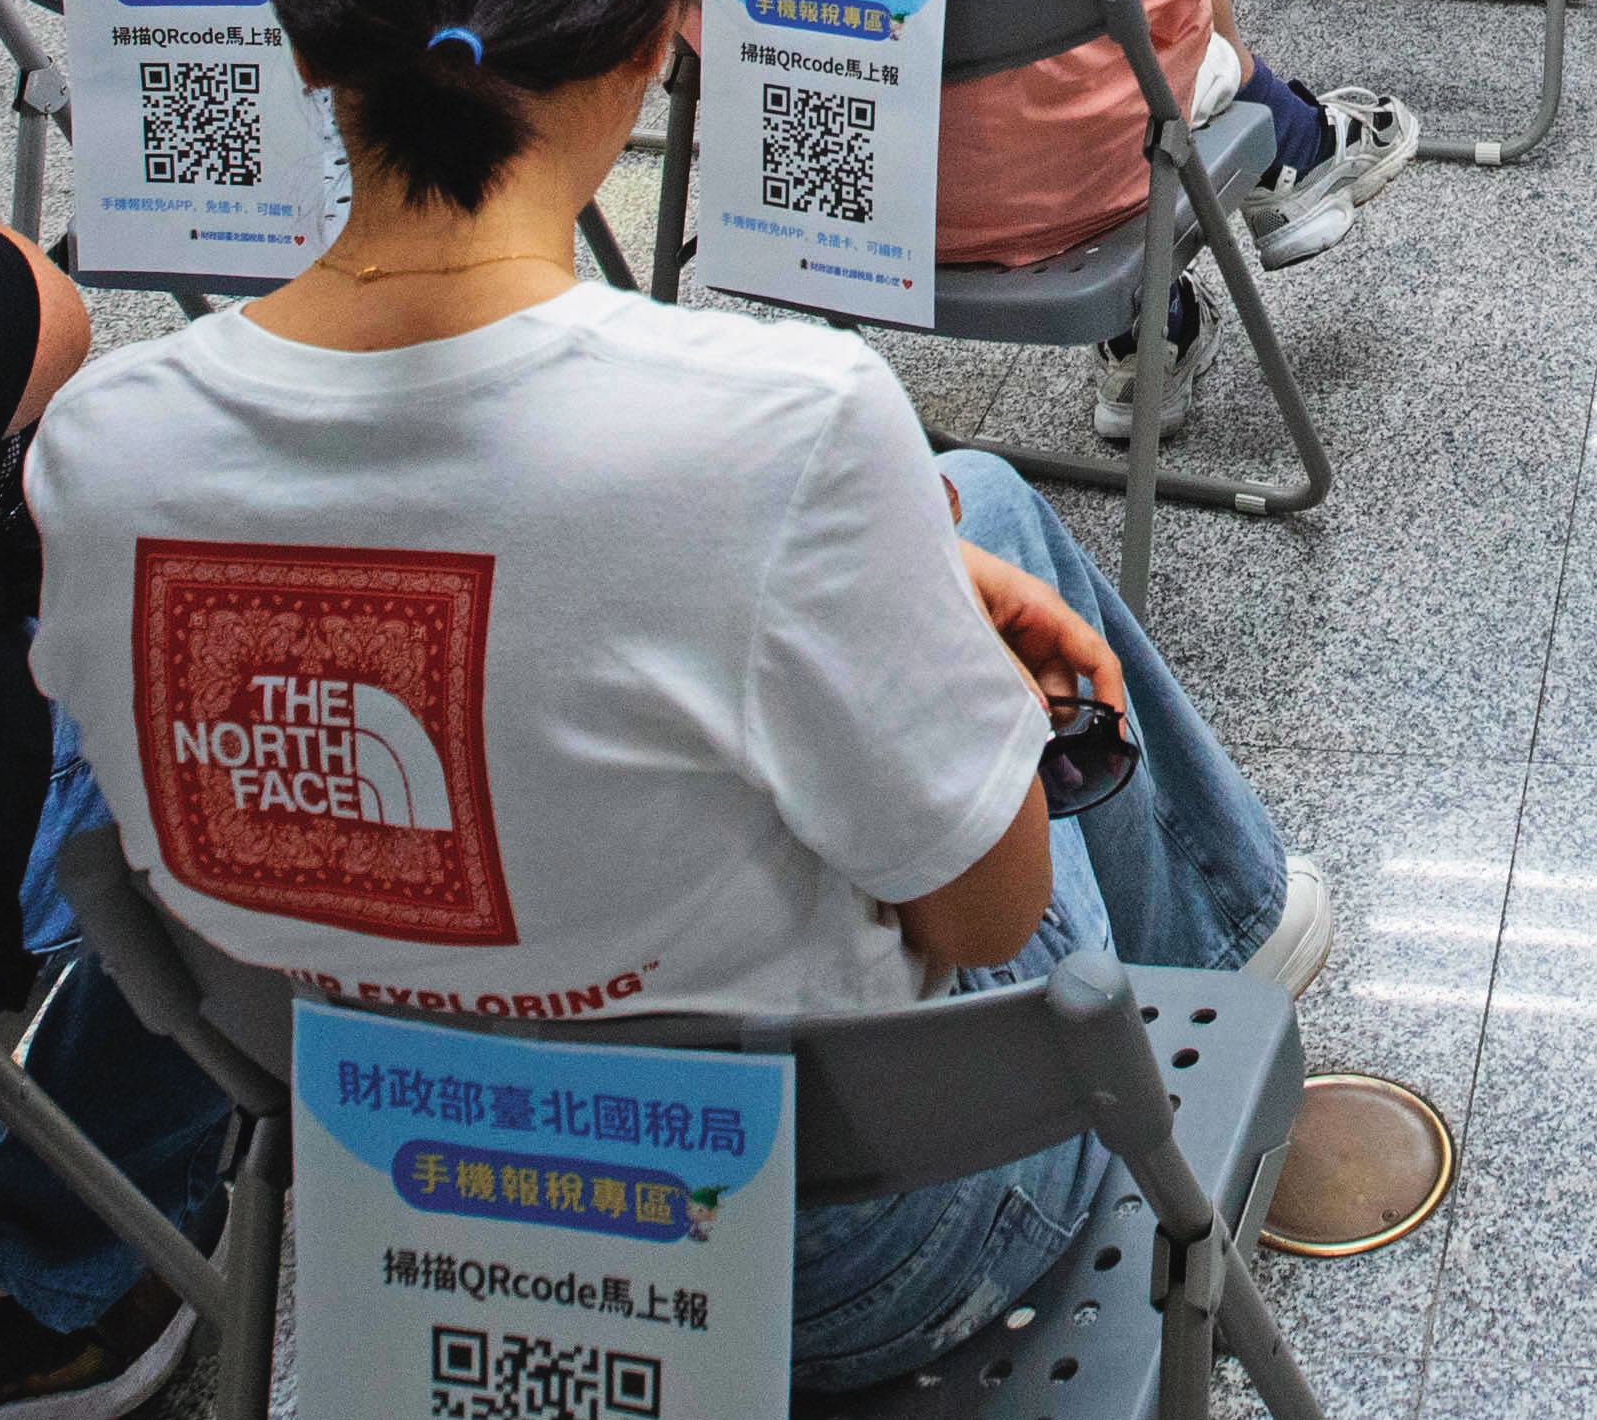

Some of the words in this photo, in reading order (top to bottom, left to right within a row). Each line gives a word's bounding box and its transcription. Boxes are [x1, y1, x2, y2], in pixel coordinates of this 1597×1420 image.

[112, 25, 283, 49] 掃描QRcode馬上報
[740, 43, 900, 87] 掃描QRcode馬上報
[252, 674, 355, 728] THE
[173, 721, 355, 775] NORTH
[230, 768, 362, 820] FACE
[337, 1060, 748, 1158] 財政部臺北國稅局
[412, 1152, 676, 1225] 手機報稅專區
[382, 1247, 710, 1332] 掃描QRcode馬上報
